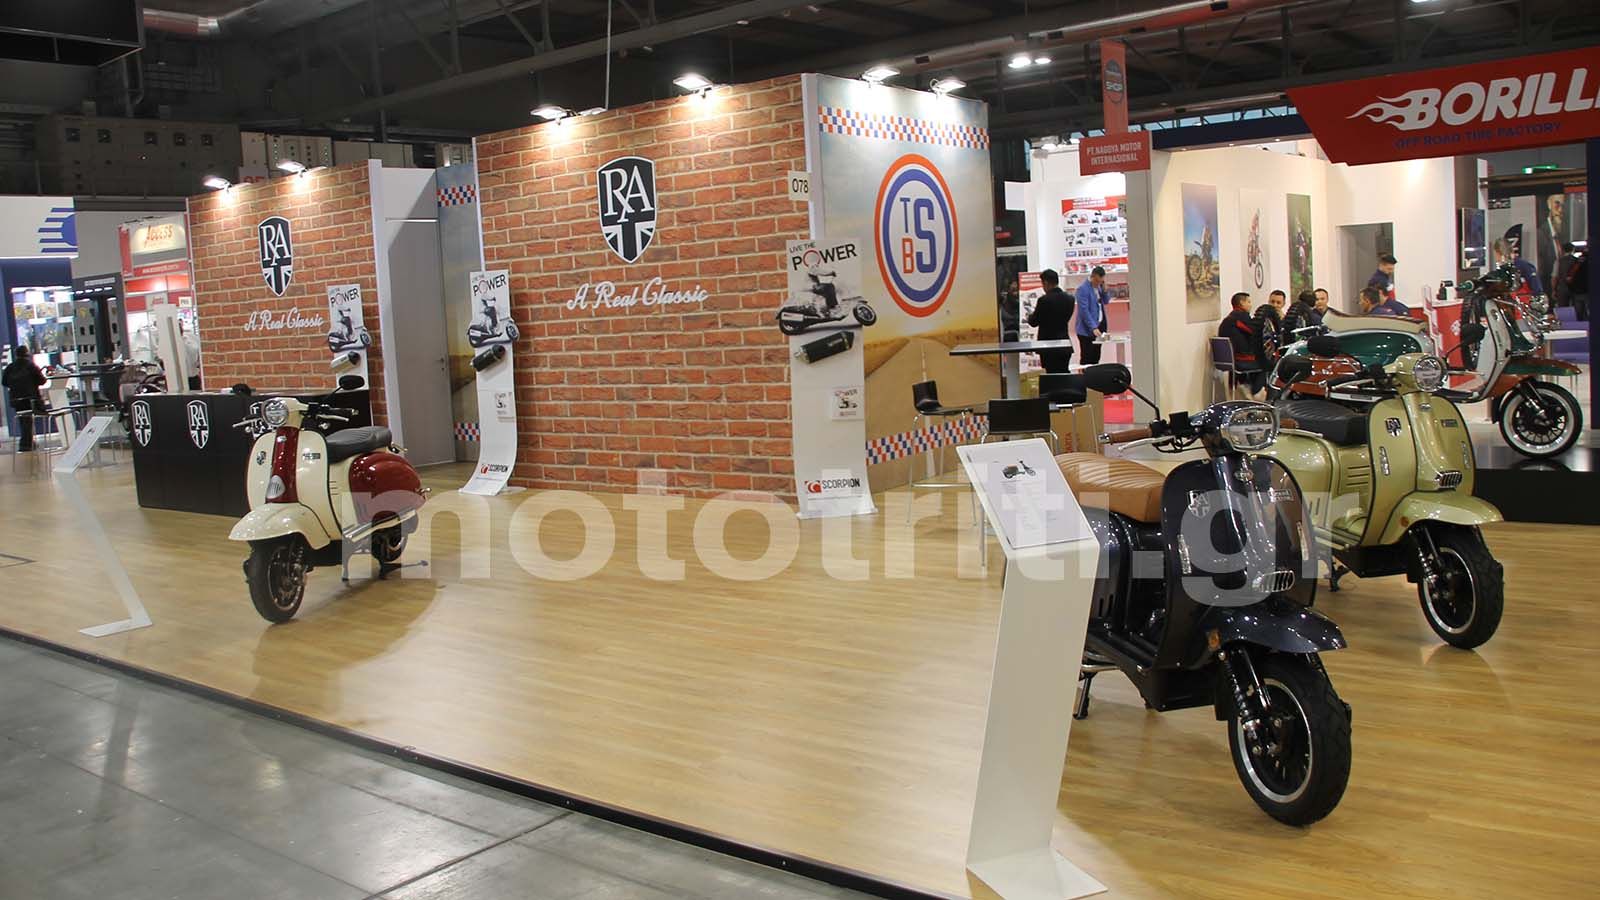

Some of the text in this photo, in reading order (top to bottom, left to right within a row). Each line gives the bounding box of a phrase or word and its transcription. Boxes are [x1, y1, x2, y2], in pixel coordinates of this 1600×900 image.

[1399, 67, 1600, 132] BORILL
[1120, 141, 1142, 152] MOTOR
[1395, 122, 1562, 150] OFF ROAD TIRE FACTORY
[1091, 153, 1138, 166] INTERNASIONAL
[601, 165, 654, 223] RA
[792, 178, 809, 194] 078
[260, 223, 292, 266] RA
[789, 244, 803, 254] LIVE
[791, 243, 858, 271] POWER
[330, 287, 360, 308] POWER
[473, 274, 507, 297] POWER
[566, 276, 710, 311] A Real Classic
[244, 306, 325, 331] A Real Classic
[134, 405, 150, 429] RA
[190, 404, 207, 431] RA
[821, 478, 861, 490] SCORPION
